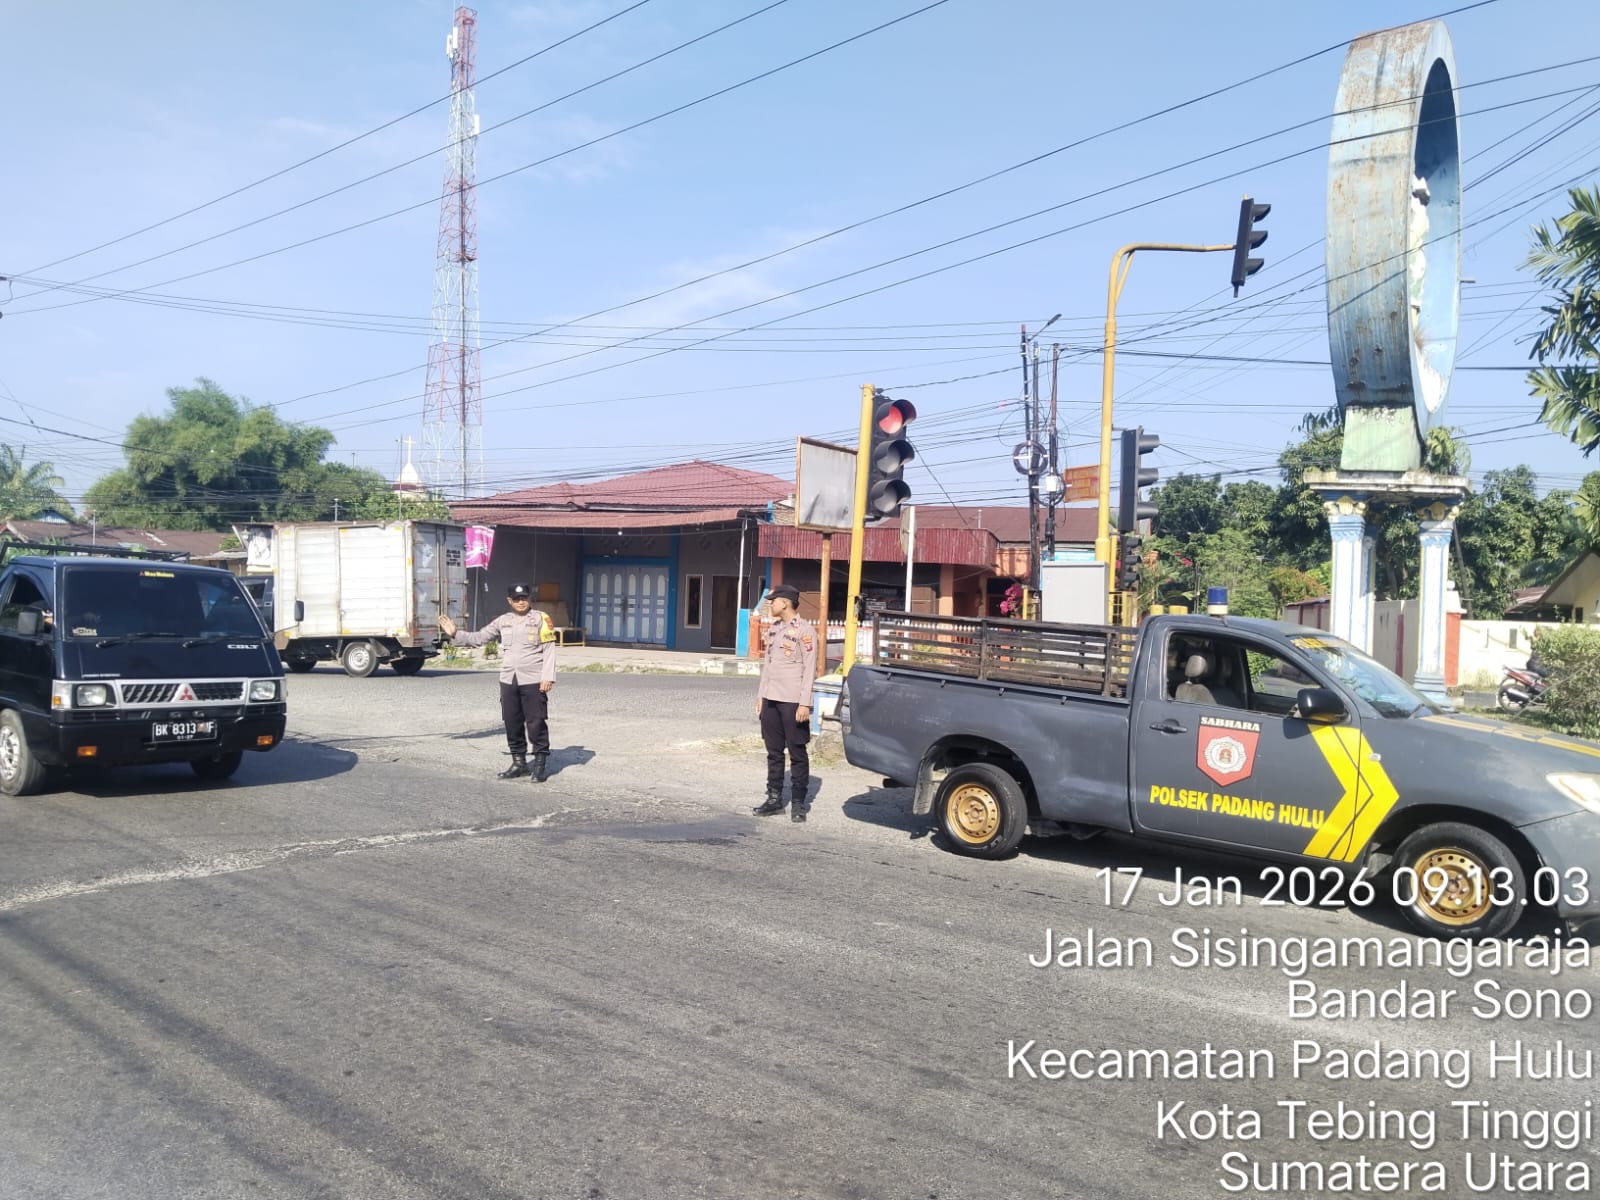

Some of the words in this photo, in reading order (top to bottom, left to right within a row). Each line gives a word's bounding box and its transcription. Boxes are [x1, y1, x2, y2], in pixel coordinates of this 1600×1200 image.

[155, 723, 168, 736] BK
[172, 722, 197, 735] 8313
[1201, 716, 1260, 731] SABHARA
[1150, 785, 1209, 811] POLSEK
[1212, 794, 1275, 821] PADANG
[1279, 804, 1326, 829] HULU
